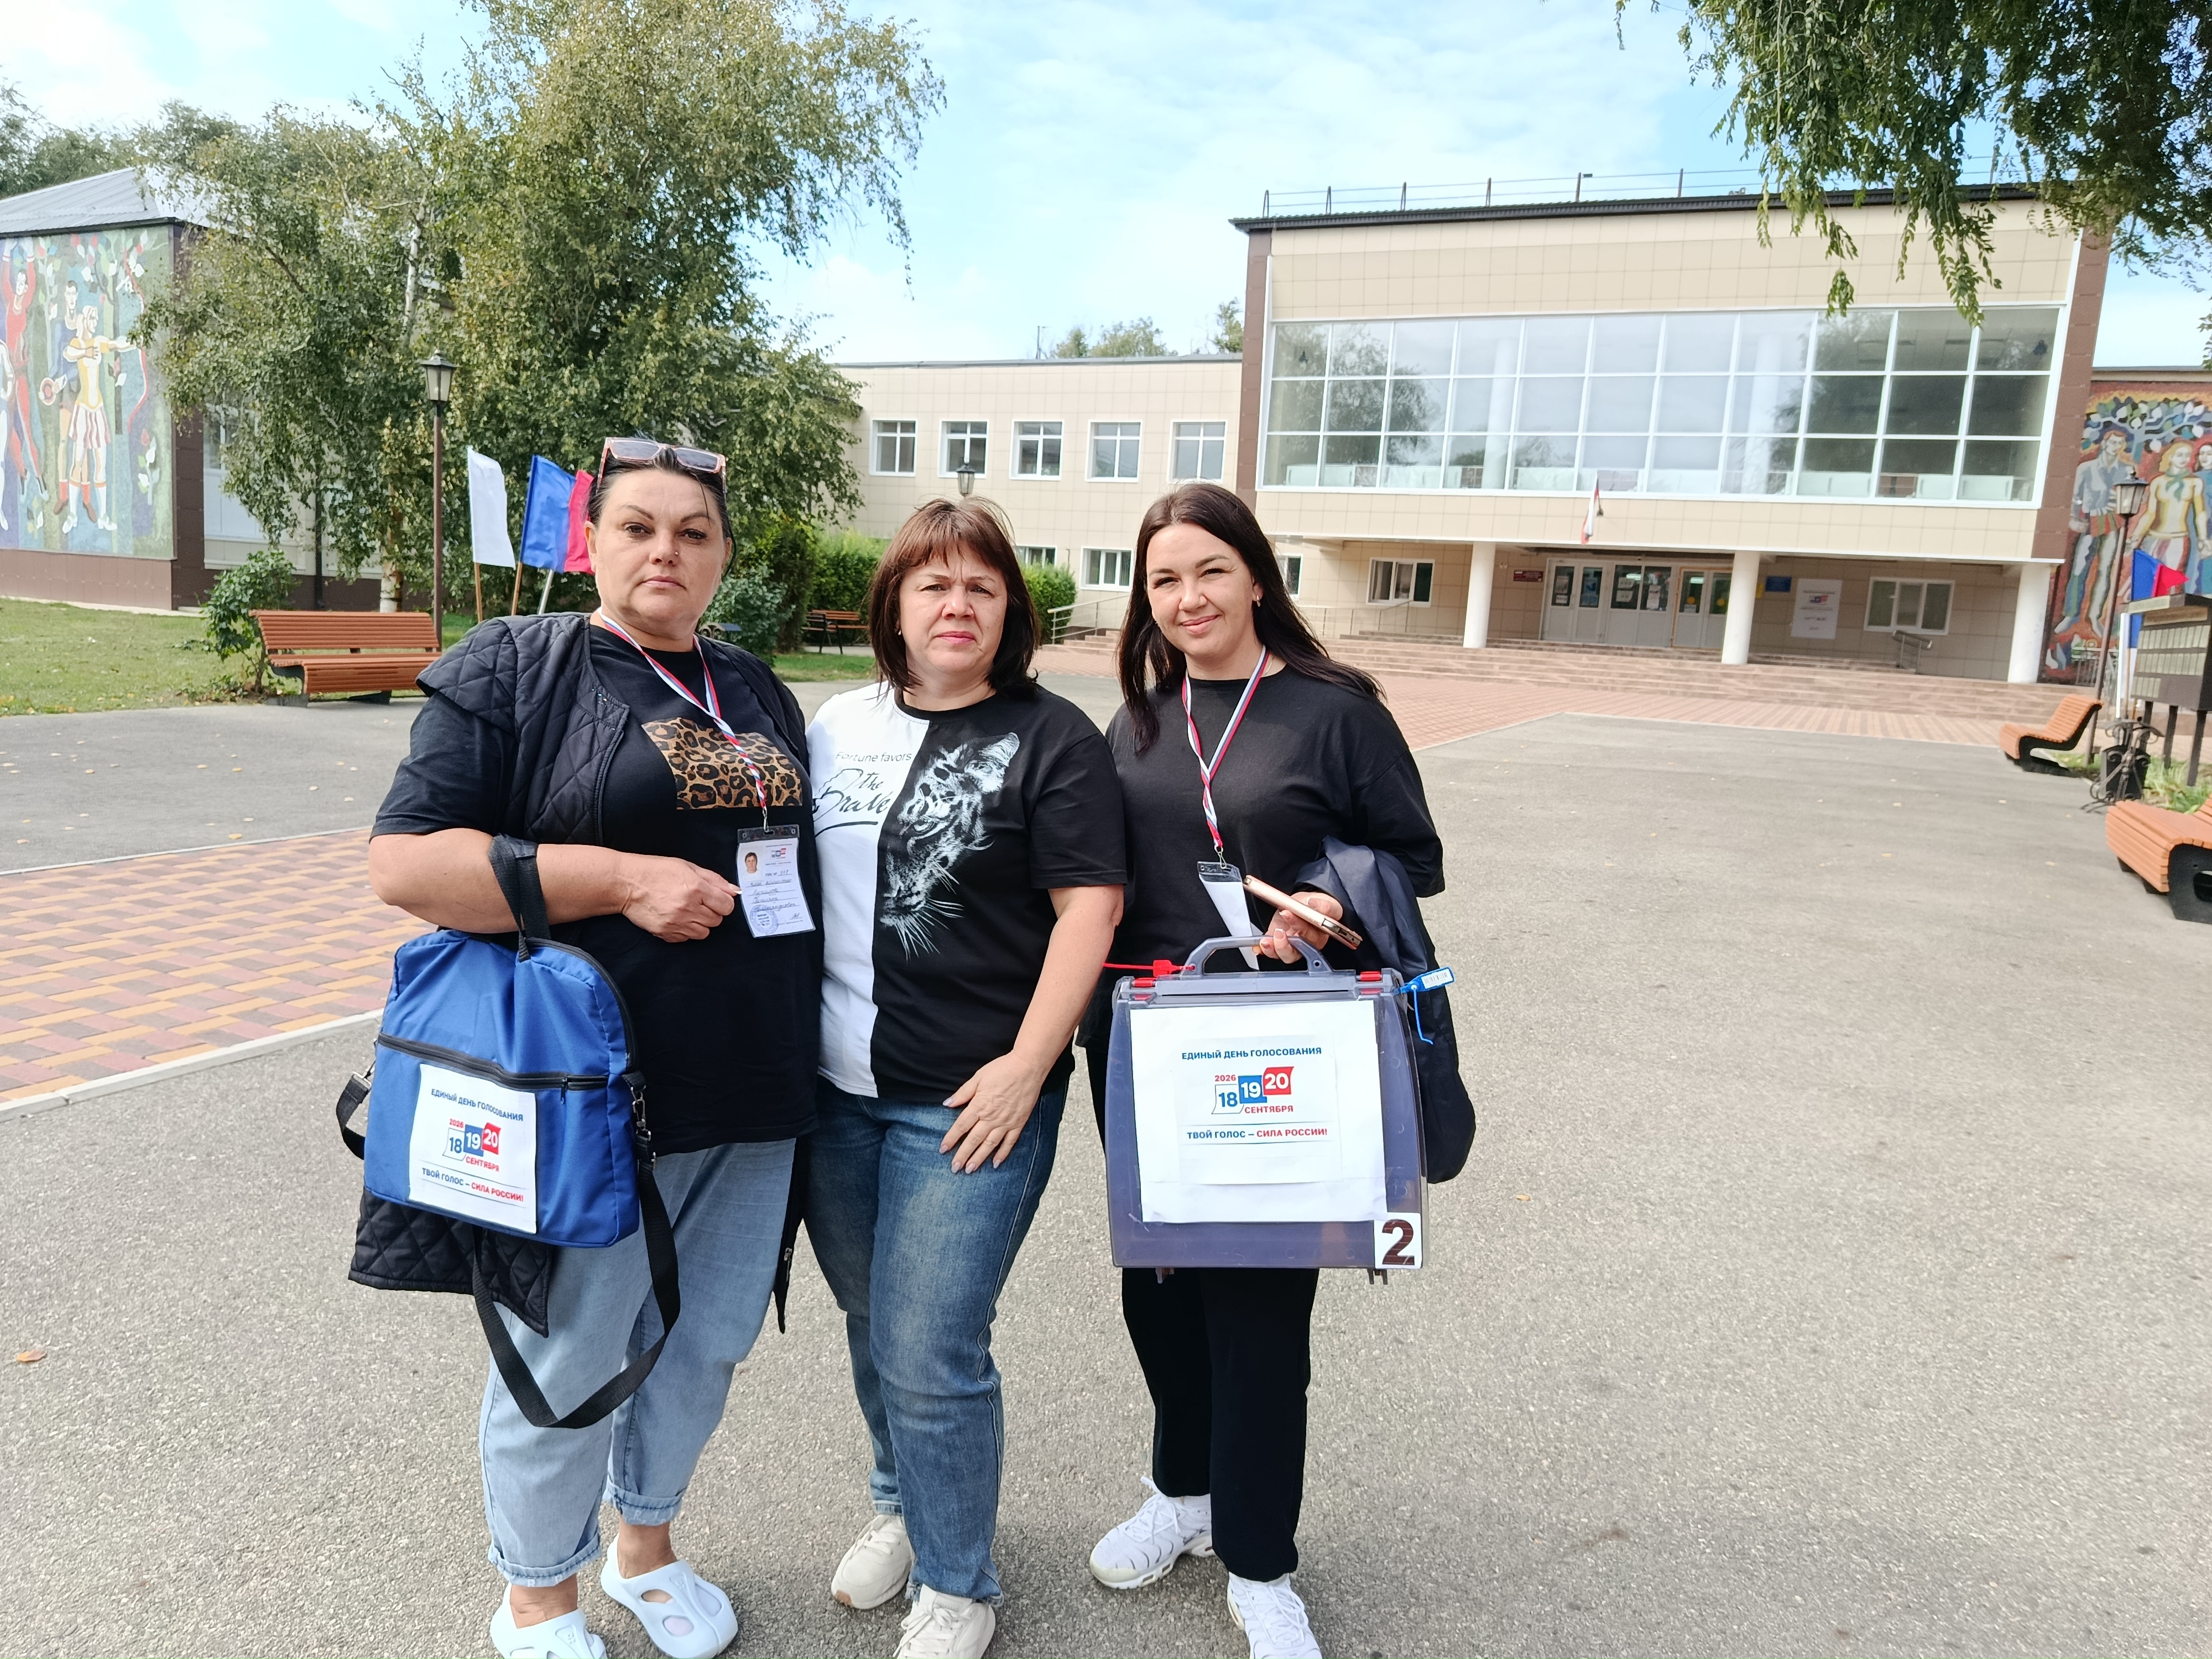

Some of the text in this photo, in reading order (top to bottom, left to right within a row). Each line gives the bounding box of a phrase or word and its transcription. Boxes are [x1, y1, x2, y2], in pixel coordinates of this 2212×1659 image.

[836, 752, 912, 762] Fortune favors
[1182, 1047, 1322, 1060] ЕДИНЫЙ ДЕНЬ ГОЛОСОВАНИЯ
[1218, 1072, 1289, 1107] 18 19 20
[431, 1088, 523, 1121] ЕДИНЫЙ ДЕНЬ ГОЛОСОВАНИЯ
[1244, 1105, 1293, 1114] СЕНТЯБРЯ
[449, 1118, 463, 1128] 2026
[449, 1129, 498, 1154] 18 19 20
[1187, 1130, 1212, 1139] ТВОЙ
[1215, 1130, 1246, 1139] ГОЛОС
[1256, 1129, 1283, 1138] СИЛА
[1285, 1128, 1327, 1136] РОССИИ!
[466, 1156, 499, 1172] СЕНТЯБРЯ
[422, 1167, 440, 1179] ТВОЙ
[441, 1173, 463, 1186] ГОЛОС
[471, 1182, 489, 1194] СИЛА
[491, 1188, 524, 1202] РОССИИ!
[1382, 1218, 1415, 1265] 2
